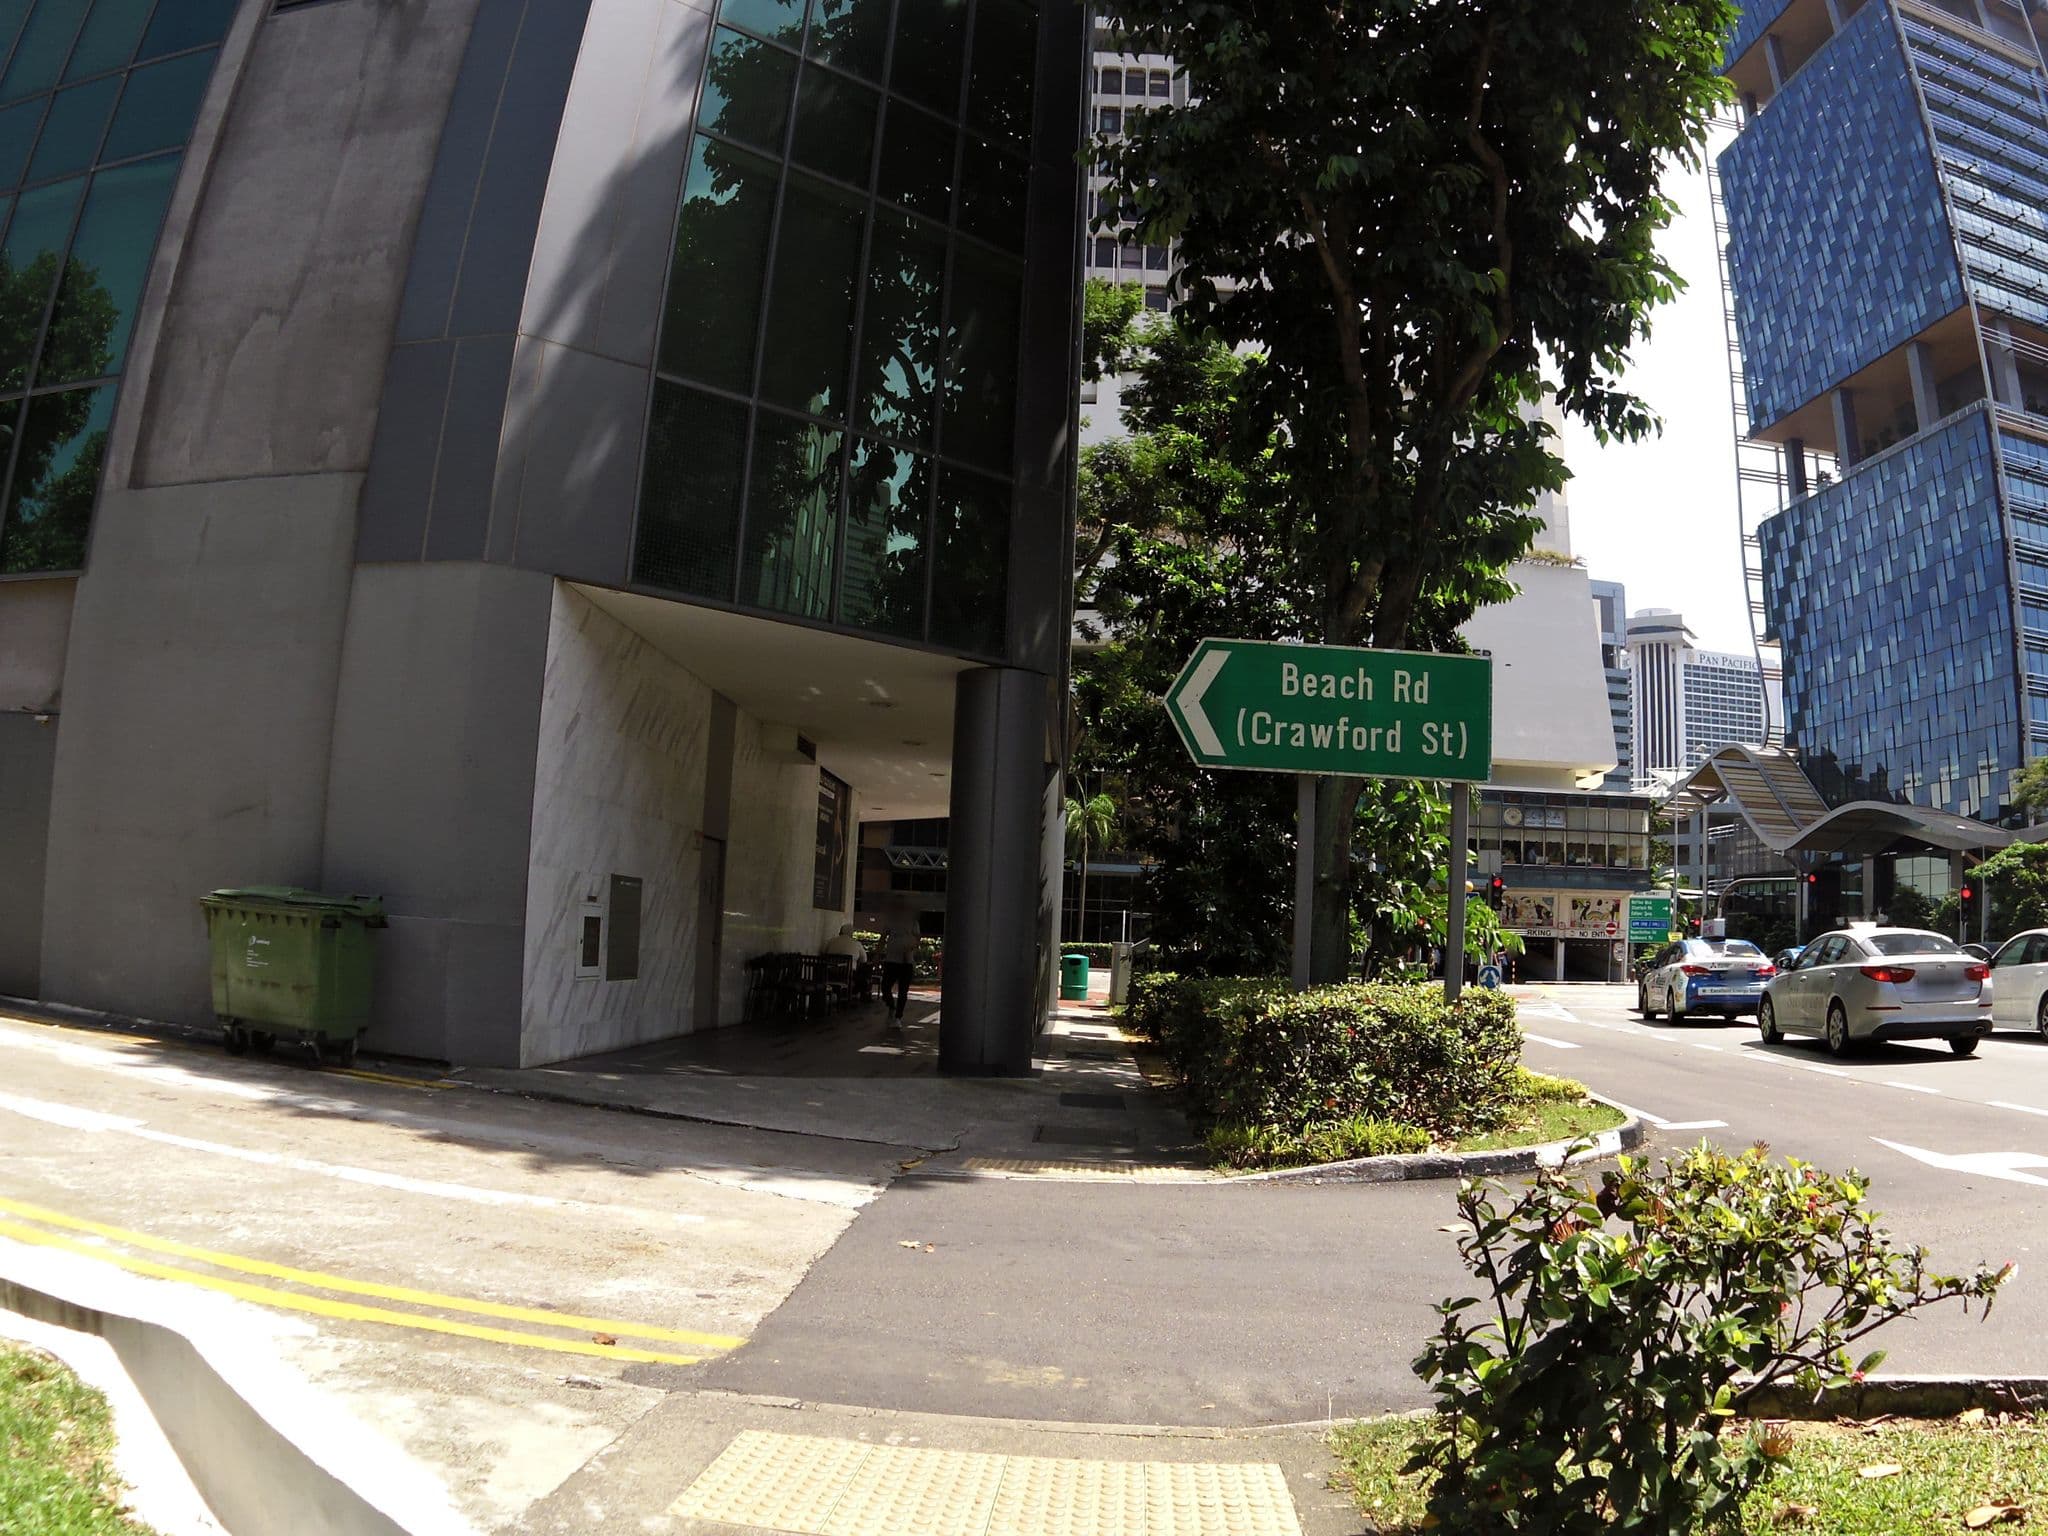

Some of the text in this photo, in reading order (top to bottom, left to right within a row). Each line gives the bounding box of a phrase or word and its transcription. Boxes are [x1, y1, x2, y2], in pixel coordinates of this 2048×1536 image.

[1700, 653, 1758, 670] PAN PACIFIC
[1282, 662, 1429, 705] Beach Rd
[1236, 707, 1468, 760] (Crawford St)
[1527, 929, 1552, 937] RKING
[1579, 930, 1589, 938] NO
